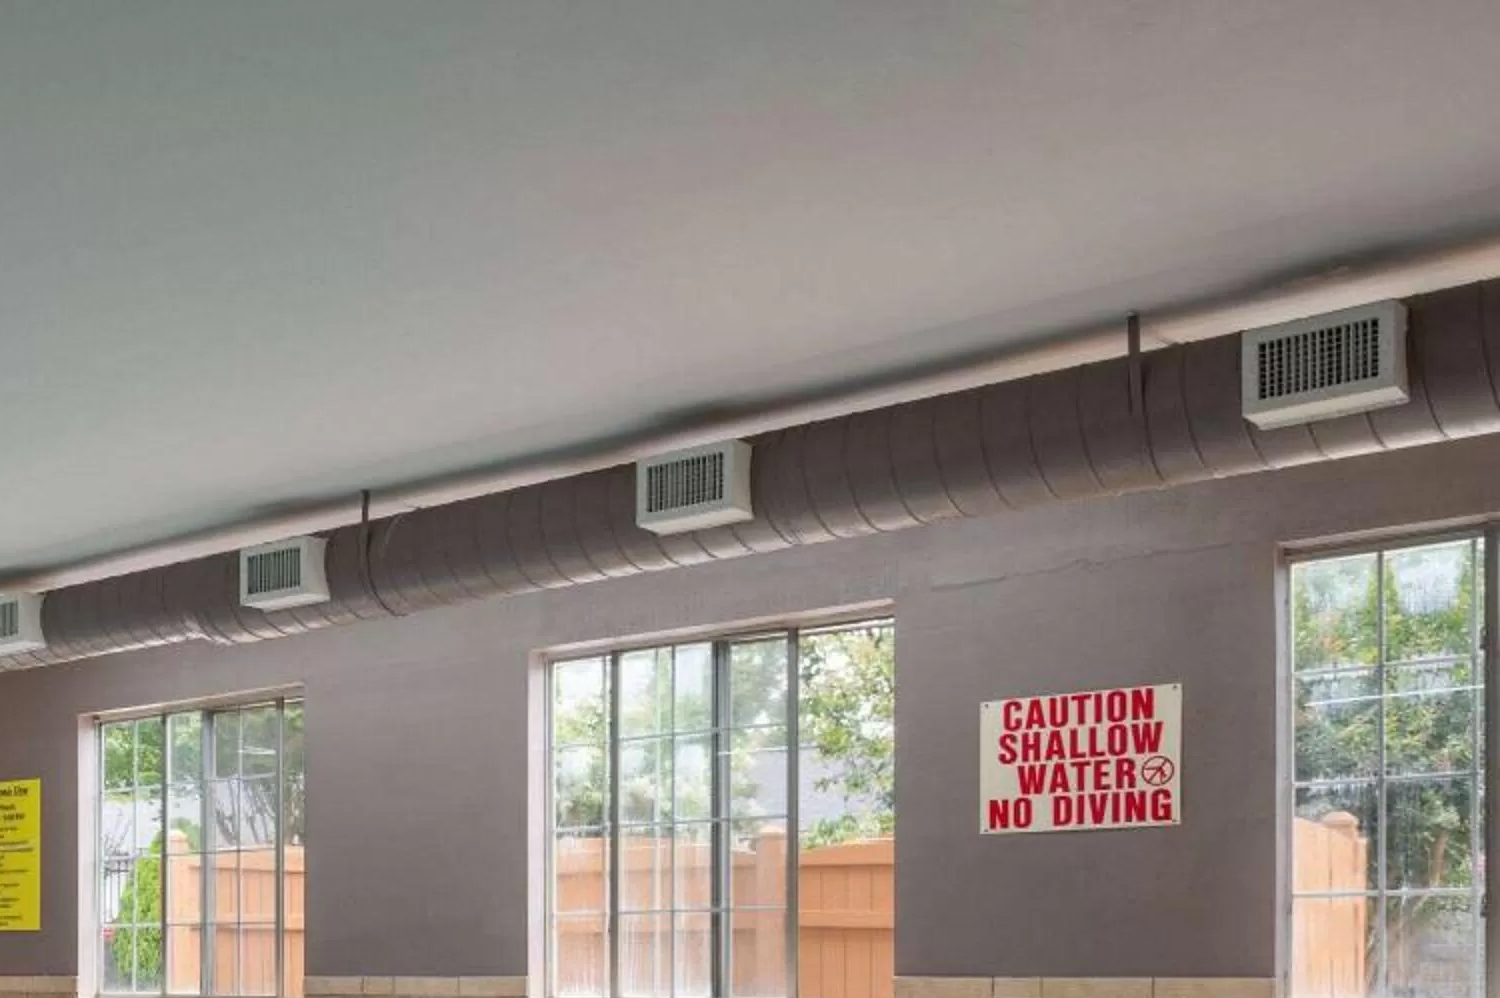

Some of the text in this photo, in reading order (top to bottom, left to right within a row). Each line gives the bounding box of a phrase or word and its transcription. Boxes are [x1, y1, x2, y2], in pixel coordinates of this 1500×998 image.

[1003, 687, 1154, 732] CAUTION
[998, 721, 1164, 764] SHALLOW
[1017, 758, 1137, 795] WATER
[989, 788, 1173, 830] NO DIVING
